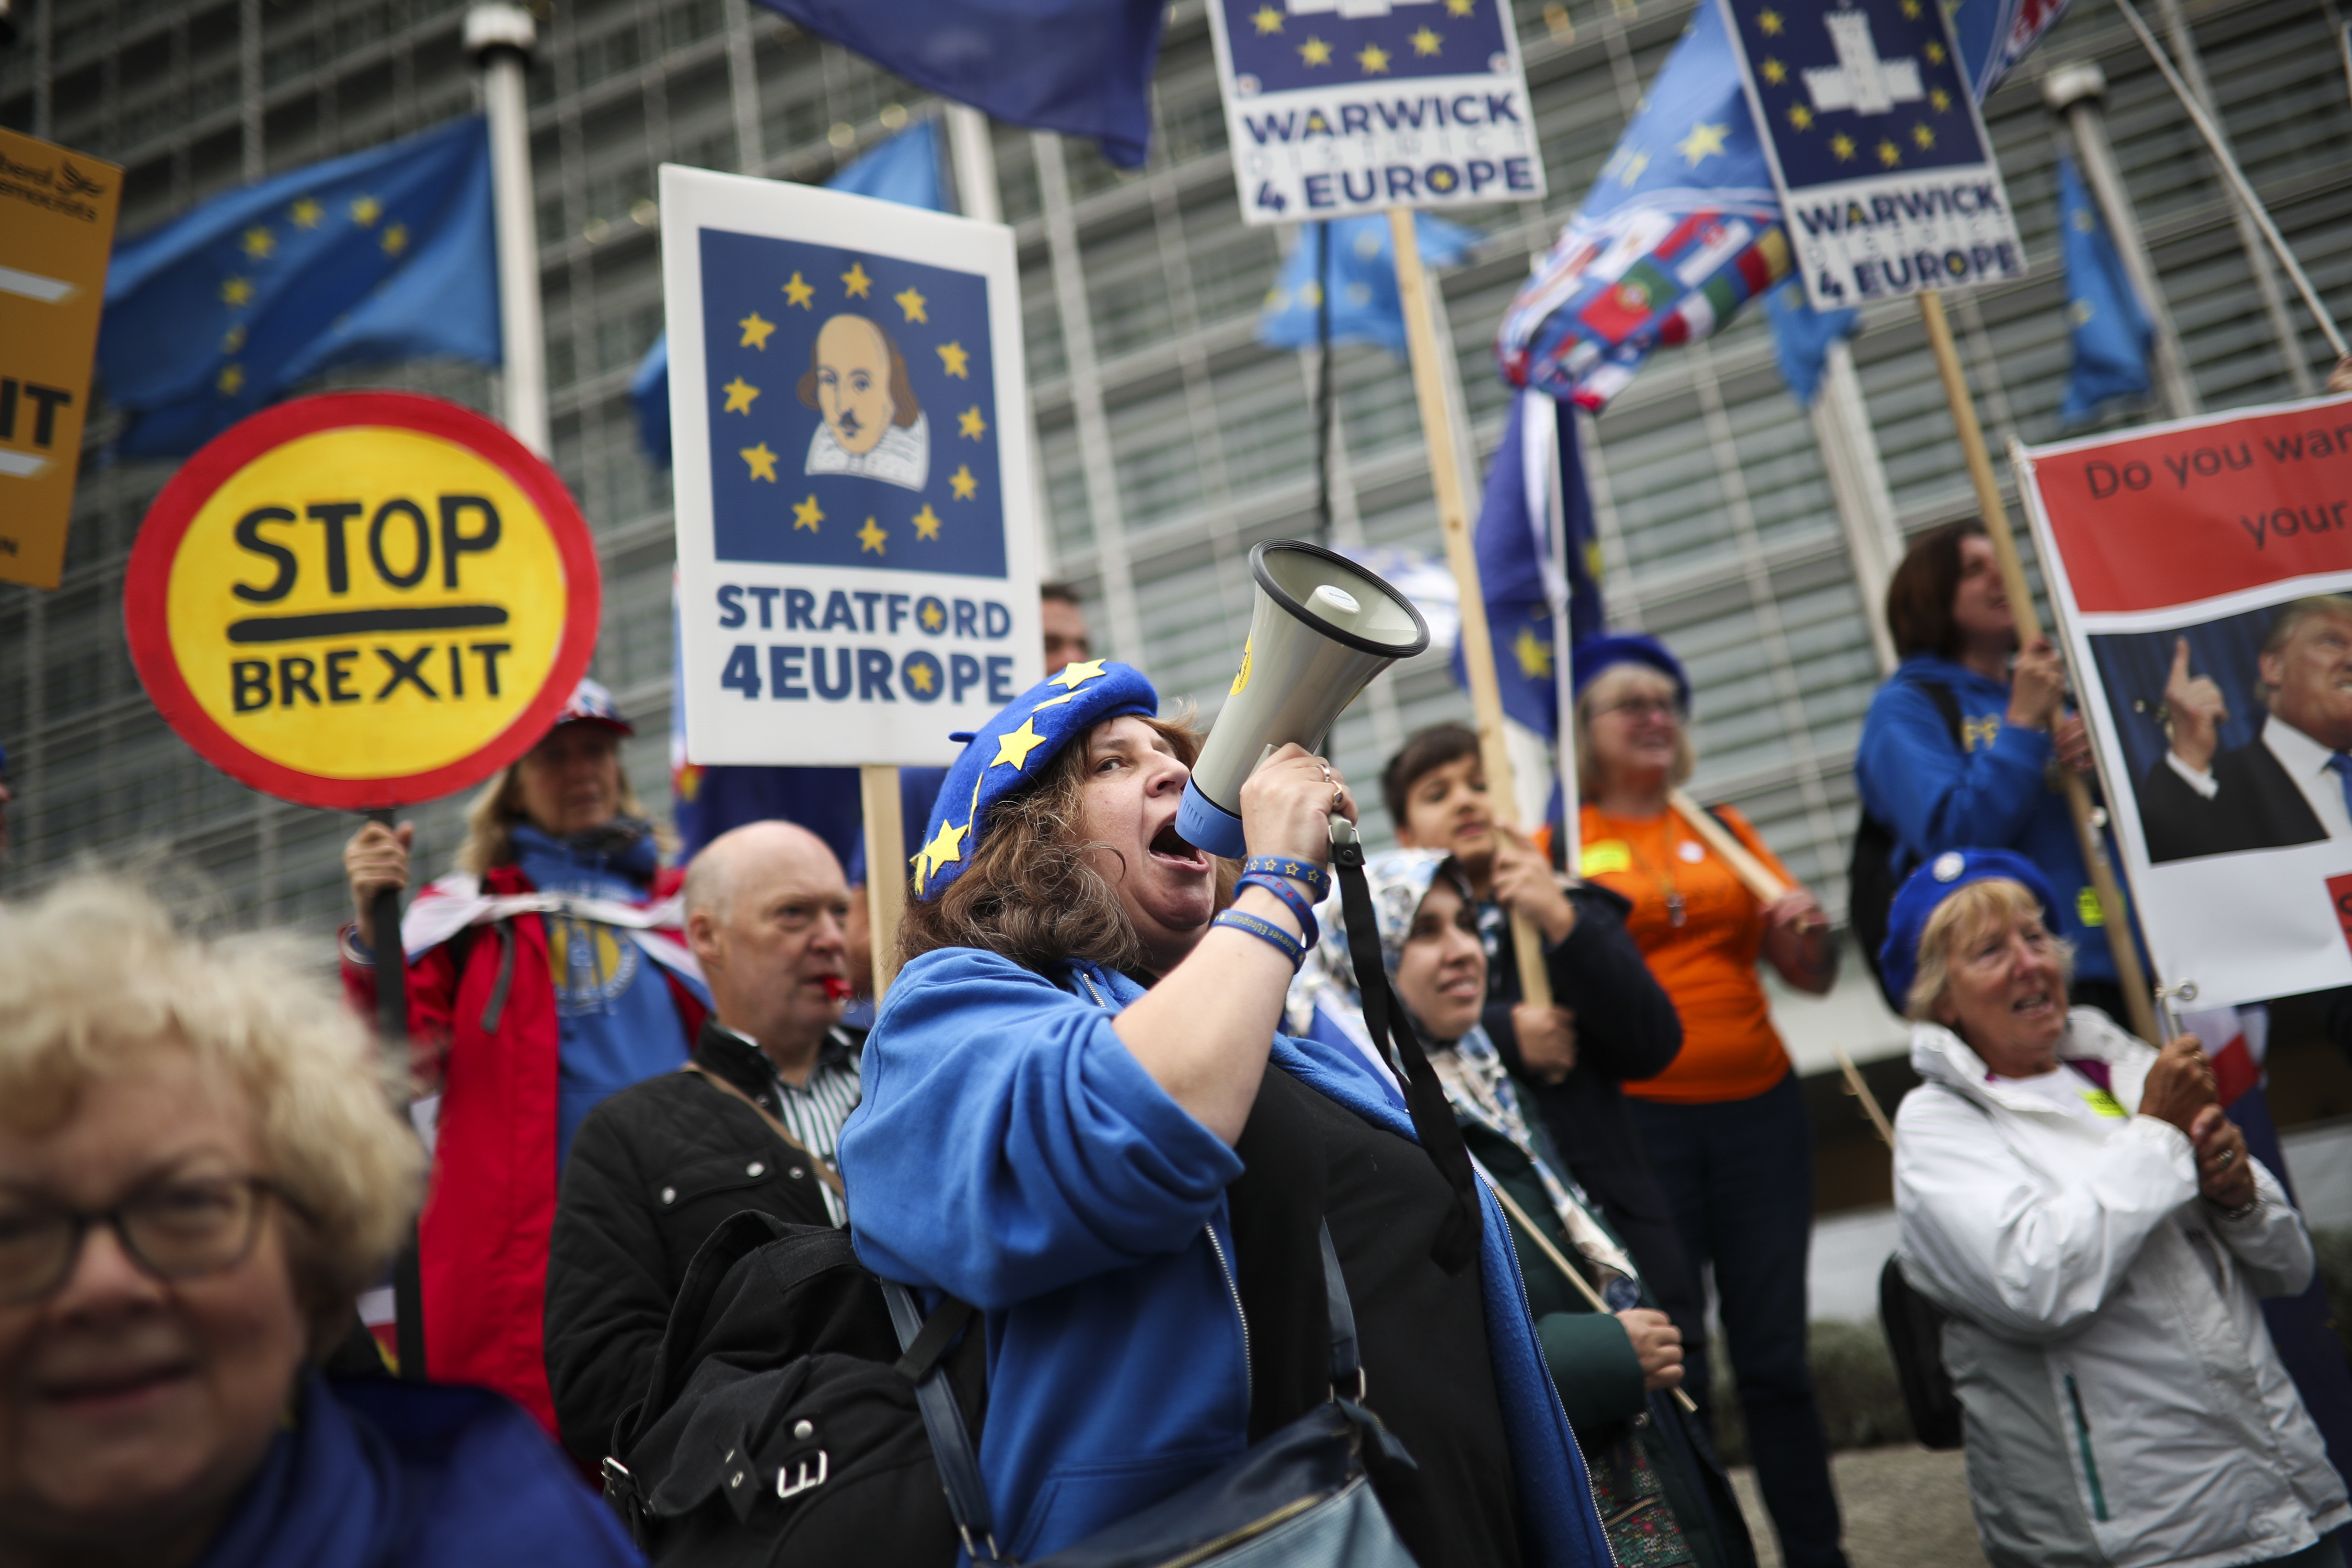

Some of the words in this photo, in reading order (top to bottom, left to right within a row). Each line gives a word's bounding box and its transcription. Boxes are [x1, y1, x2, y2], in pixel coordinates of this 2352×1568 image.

[1242, 92, 1520, 145] WARWICK
[1256, 179, 1287, 212] 4
[1305, 157, 1535, 209] EUROPE
[1797, 182, 2001, 236] WARWICK
[1819, 270, 1845, 303] 4
[1854, 241, 2017, 296] EUROPE
[2084, 459, 2152, 500] Do
[2164, 440, 2254, 490] you
[231, 494, 502, 603] STOP
[2240, 500, 2347, 551] your
[717, 583, 1012, 639] STRATFORD
[231, 643, 512, 717] BREXIT
[720, 643, 1017, 705] 4EUROPE
[1268, 929, 1298, 955] Forever
